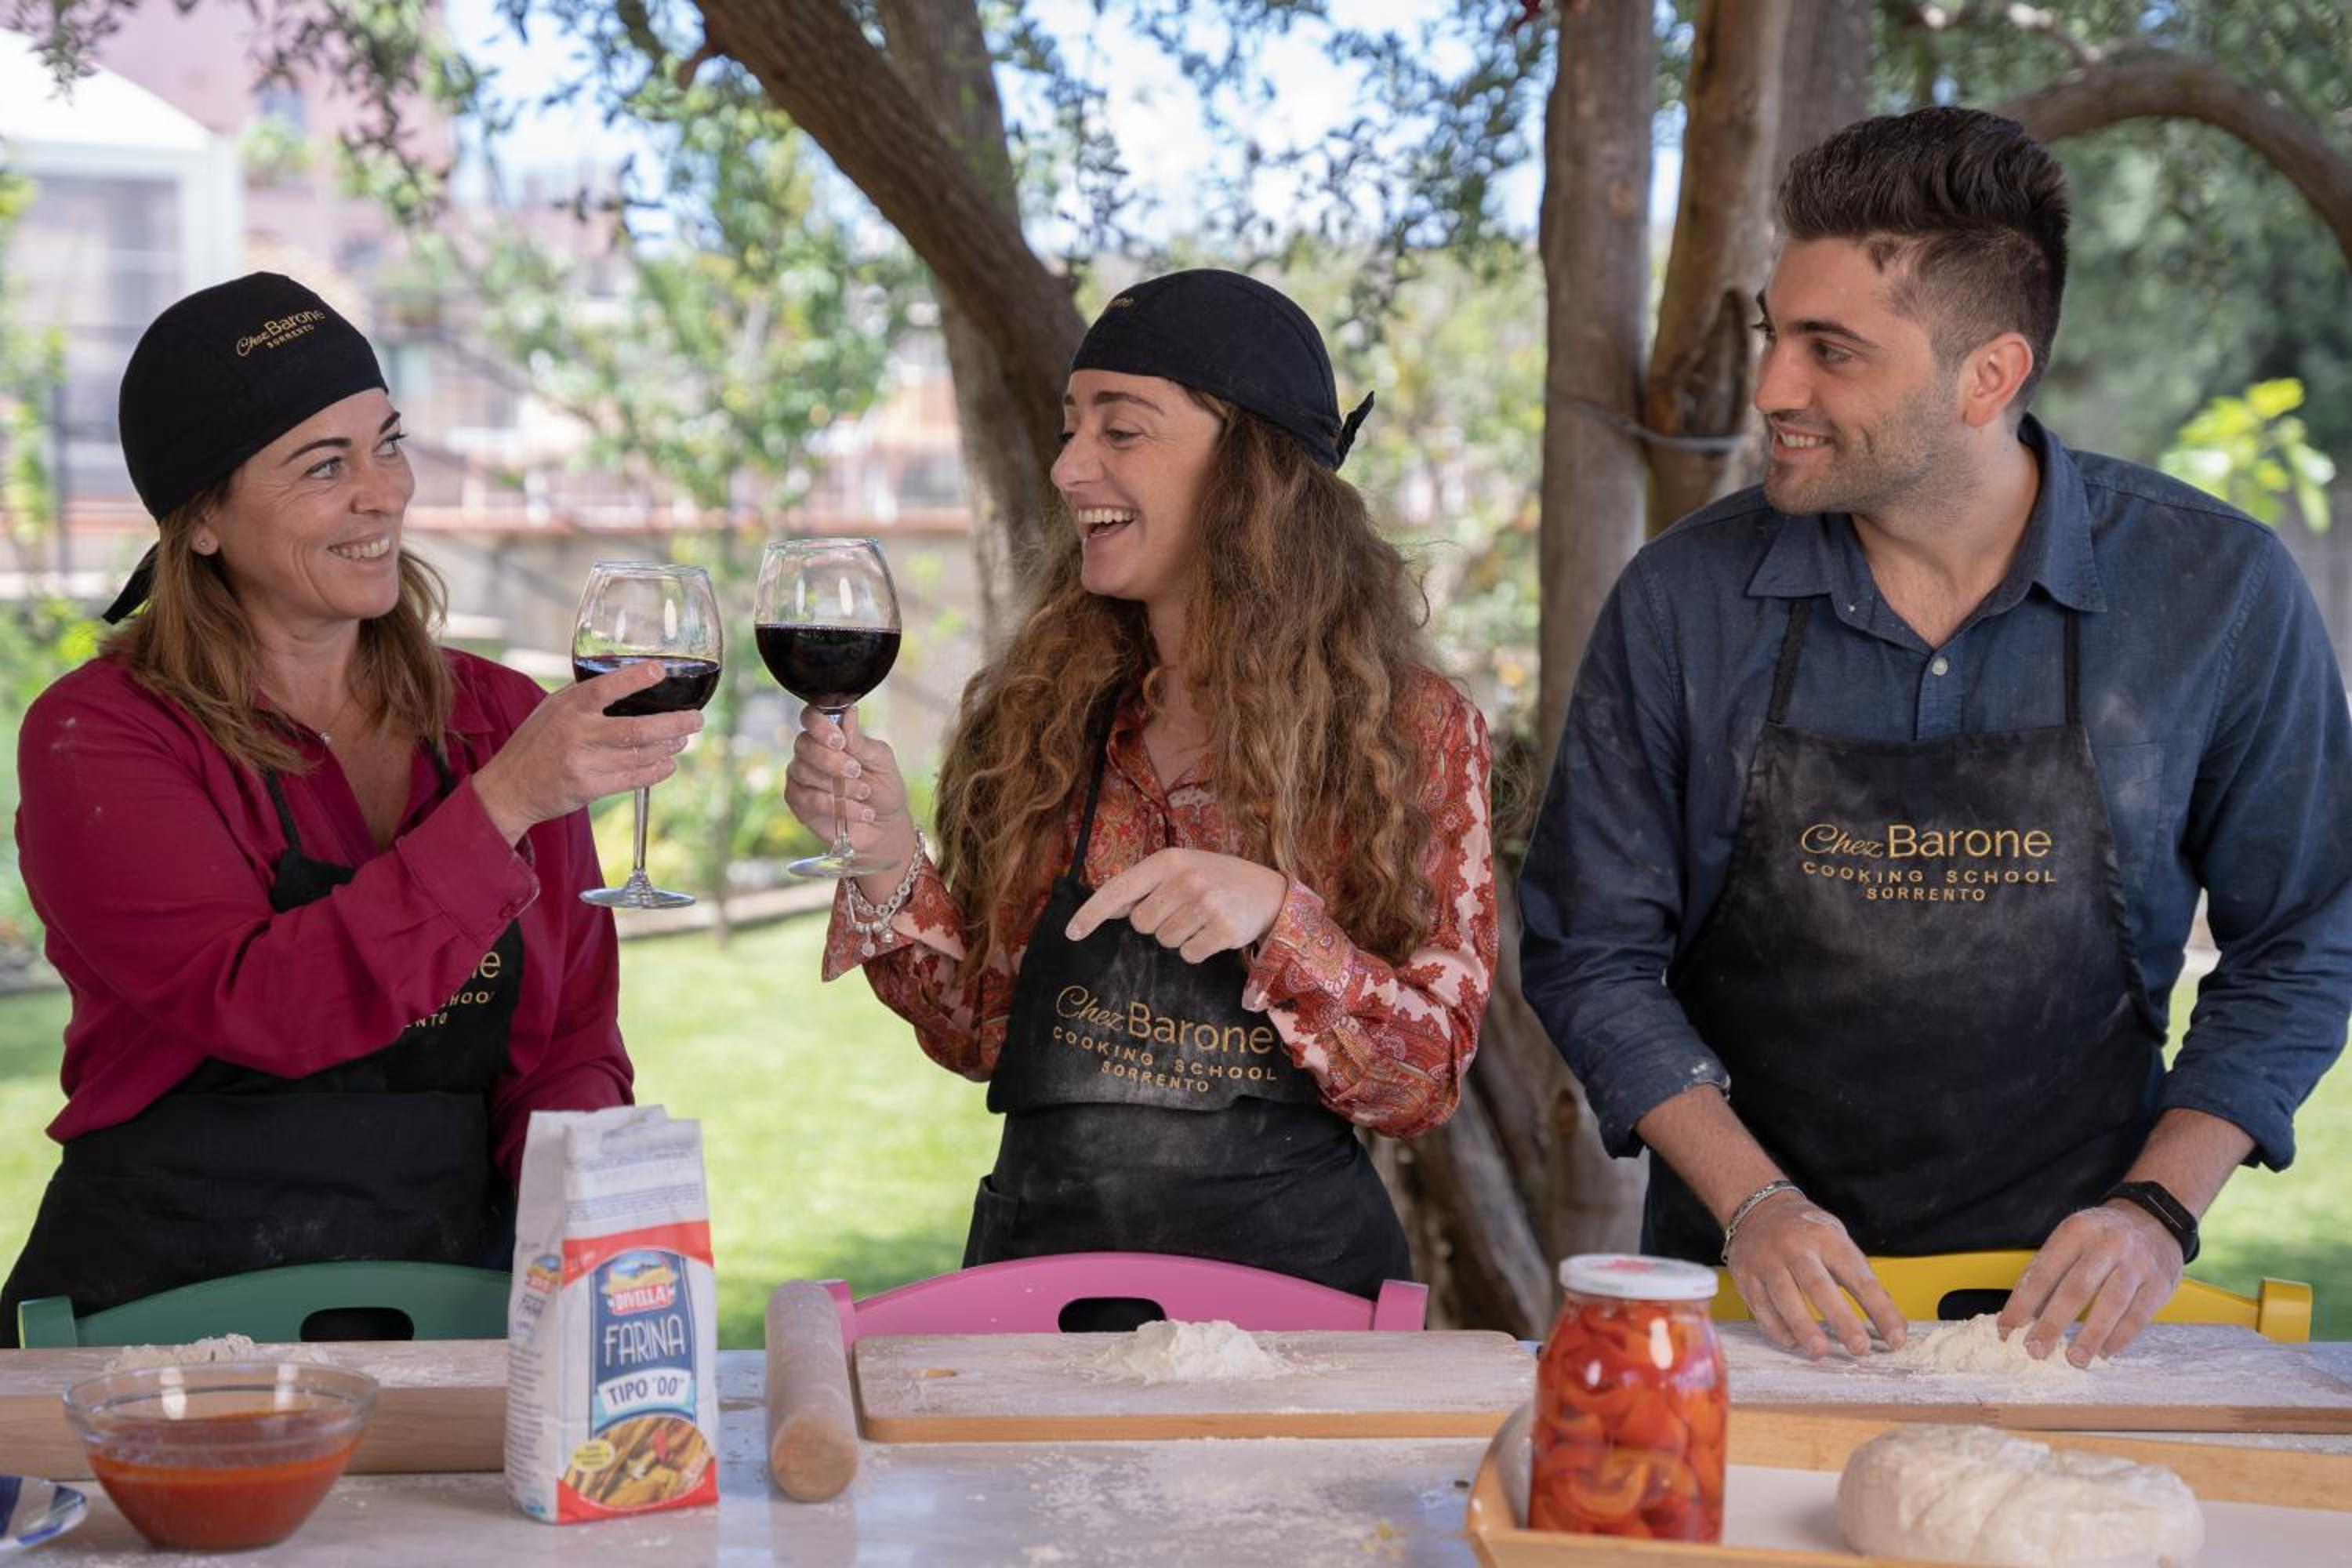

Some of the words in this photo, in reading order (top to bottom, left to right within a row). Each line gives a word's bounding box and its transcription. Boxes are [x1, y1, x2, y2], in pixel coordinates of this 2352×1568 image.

[263, 310, 326, 336] Barone
[1801, 824, 1883, 858] Chez
[1888, 824, 2053, 858] Barone
[1802, 861, 1923, 884] COOKING
[1947, 869, 2057, 884] SCHOOL
[1866, 887, 1986, 902] SORRENTO
[1056, 985, 1125, 1032] Chez
[1128, 1000, 1274, 1054] Barone
[1053, 1025, 1154, 1066] COOKING
[1174, 1057, 1277, 1080] SCHOOL
[1101, 1060, 1209, 1093] SORRENTO
[603, 1314, 685, 1367] FARINA
[607, 1378, 648, 1406] TIPO
